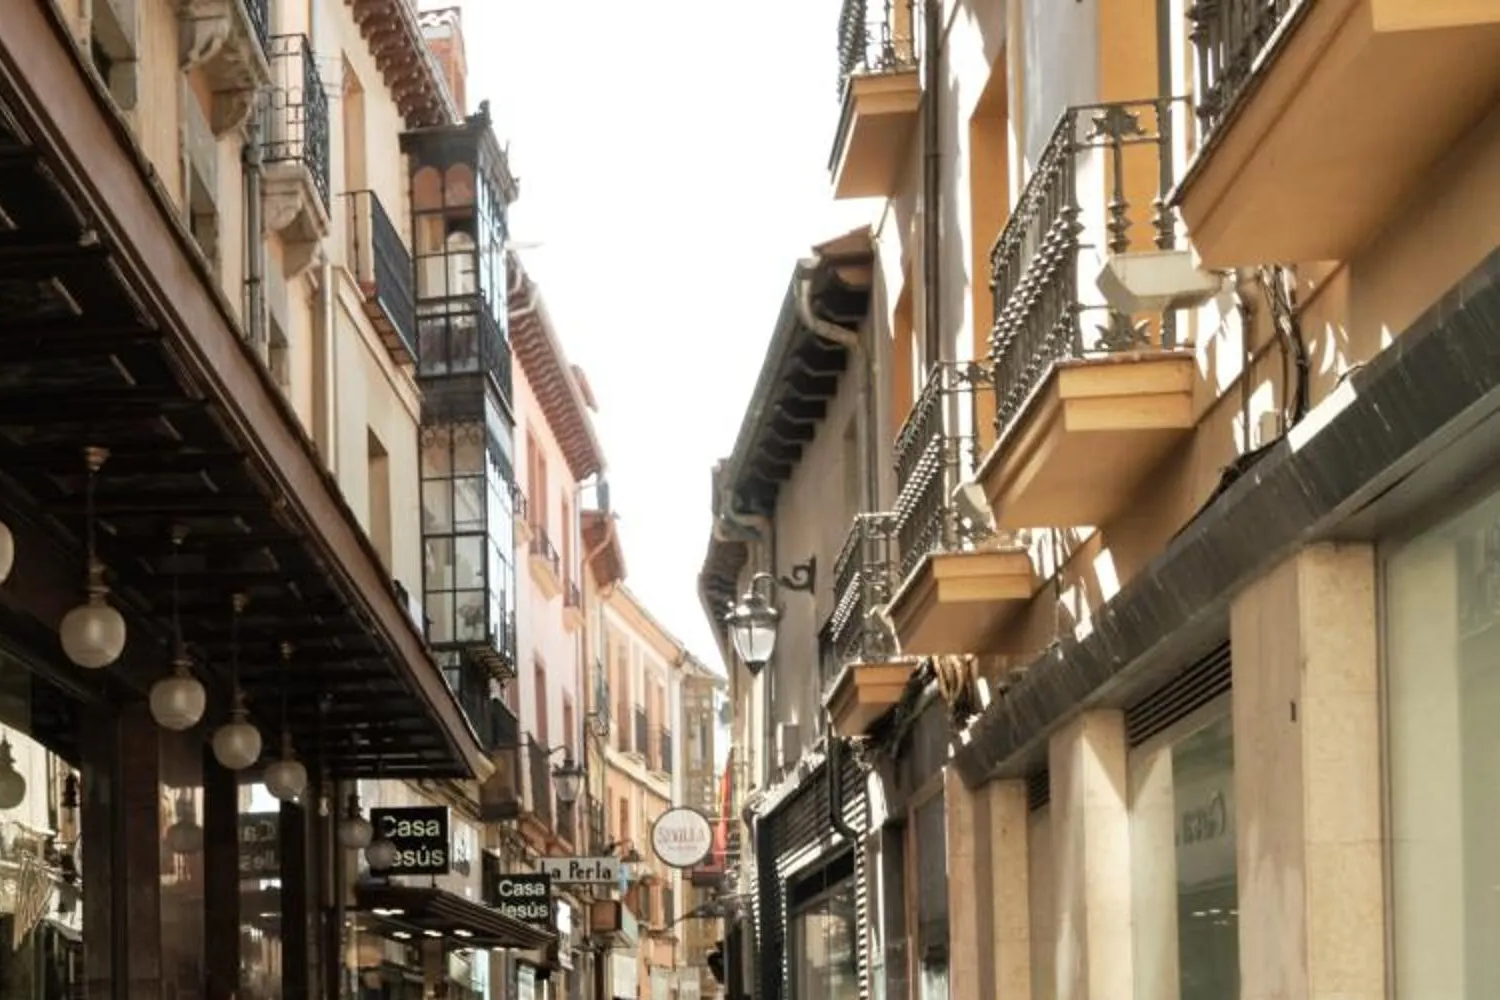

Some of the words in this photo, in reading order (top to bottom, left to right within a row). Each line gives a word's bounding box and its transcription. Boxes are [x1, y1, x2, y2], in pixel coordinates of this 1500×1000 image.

[381, 815, 440, 838] Casa
[389, 845, 445, 868] esús
[540, 861, 562, 879] La
[569, 860, 612, 879] Perla
[499, 880, 546, 897] Casa
